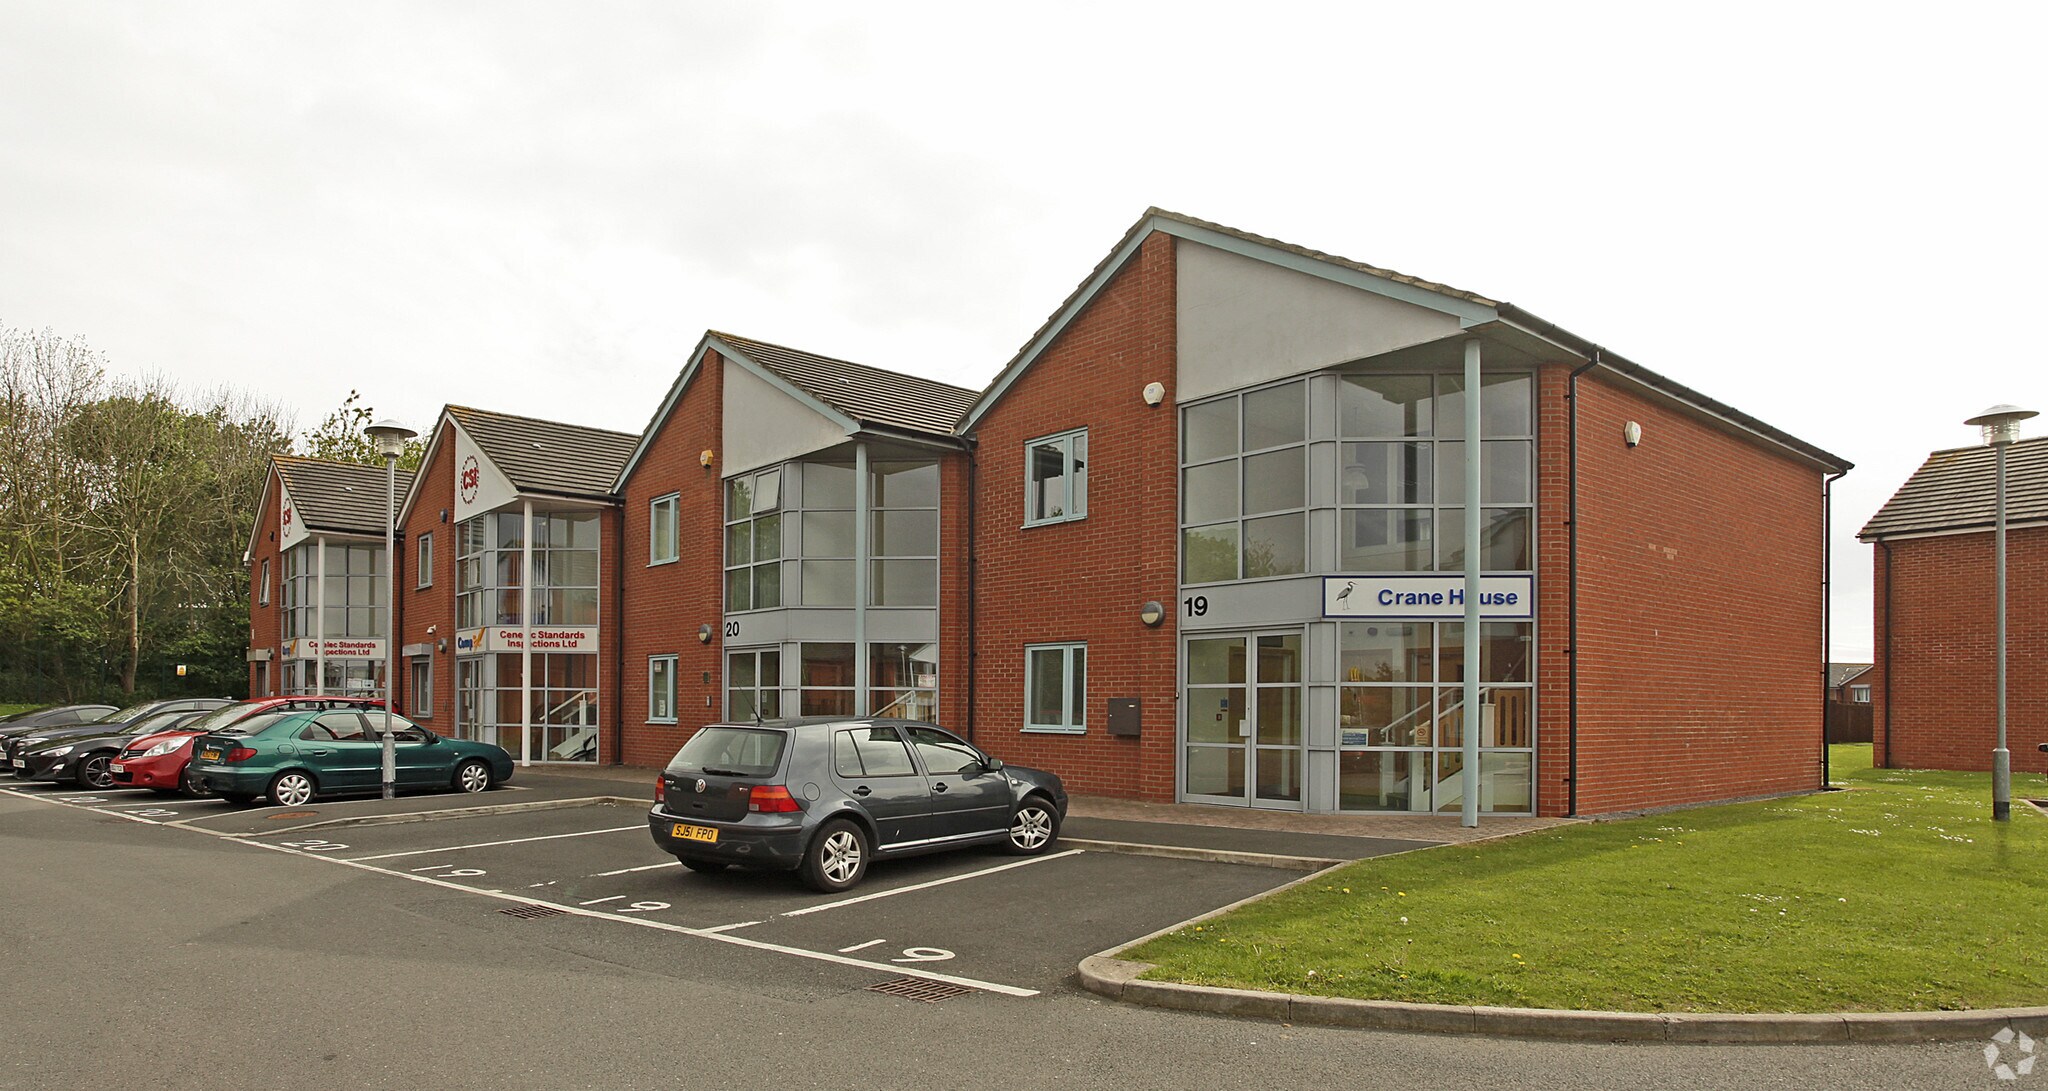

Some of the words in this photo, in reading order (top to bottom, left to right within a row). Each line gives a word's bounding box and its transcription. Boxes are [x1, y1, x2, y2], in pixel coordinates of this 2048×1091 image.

[1377, 589, 1444, 606] Crane
[1449, 588, 1519, 606] Huse
[1184, 596, 1208, 617] 19
[500, 630, 536, 639] Cenec
[538, 630, 585, 639] Standards
[726, 621, 740, 637] 20
[507, 639, 560, 648] Insctions
[562, 639, 577, 648] Ltd
[124, 808, 179, 817] 20
[675, 825, 693, 838] SJ51
[695, 827, 714, 840] FPO
[280, 839, 350, 851] 20
[410, 864, 487, 878] 19
[579, 895, 671, 912] 19
[838, 938, 956, 962] 19
